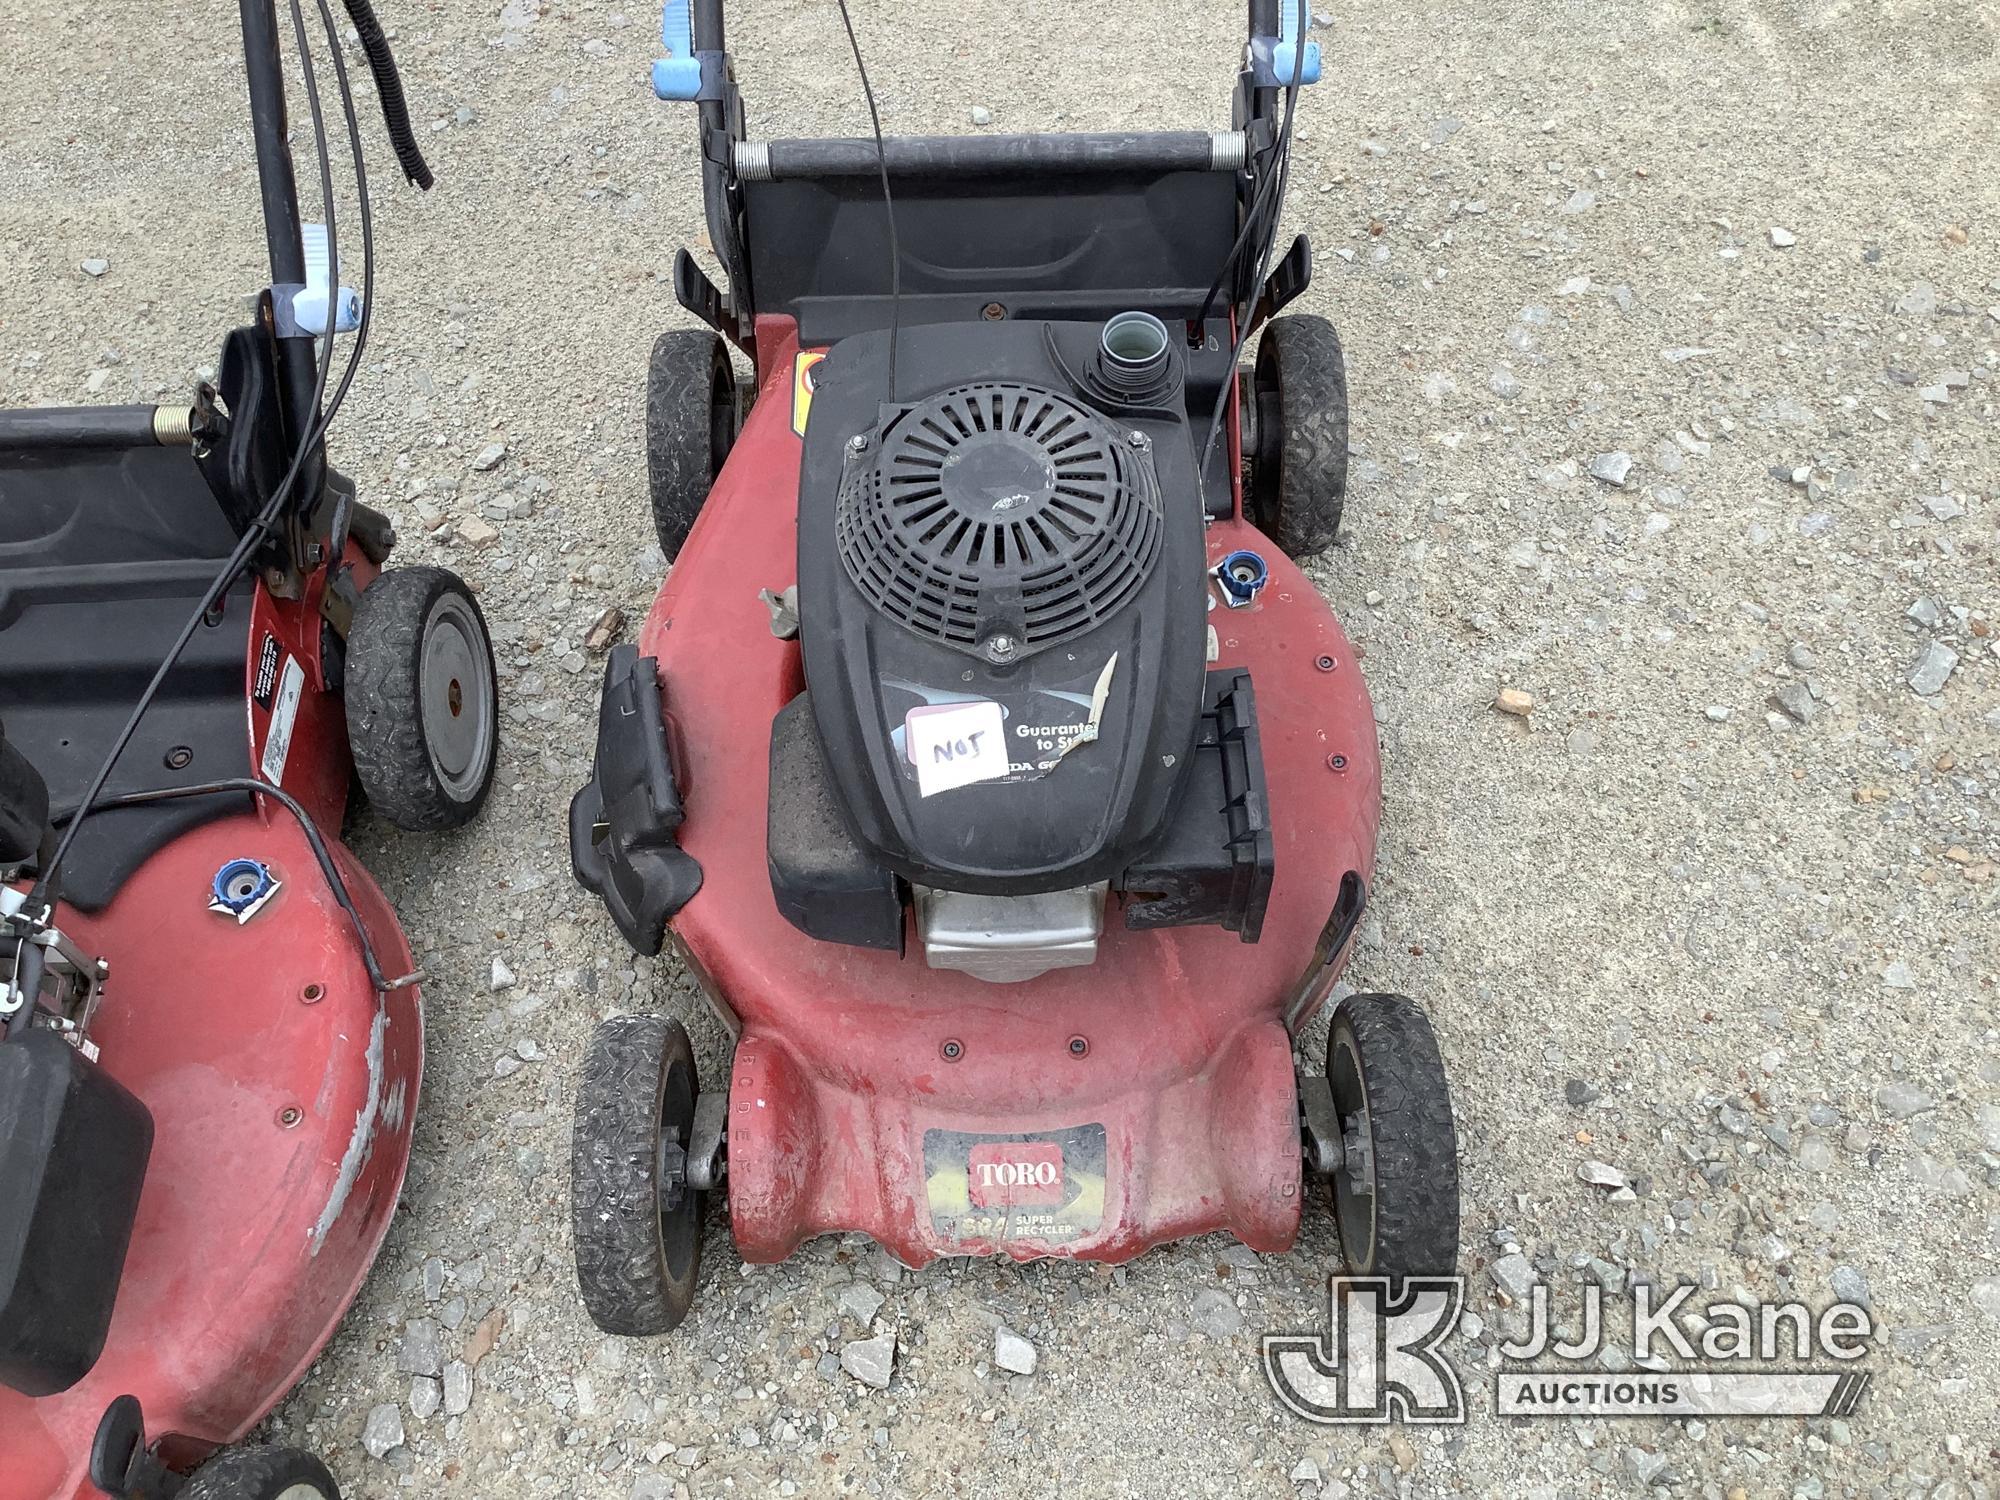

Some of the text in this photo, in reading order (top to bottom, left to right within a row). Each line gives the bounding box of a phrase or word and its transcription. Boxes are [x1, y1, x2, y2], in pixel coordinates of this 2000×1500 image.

[1016, 723, 1096, 738] Guarante
[1036, 738, 1053, 751] to
[1015, 1215, 1054, 1225] SUPER
[1015, 1224, 1073, 1236] RECYCLER
